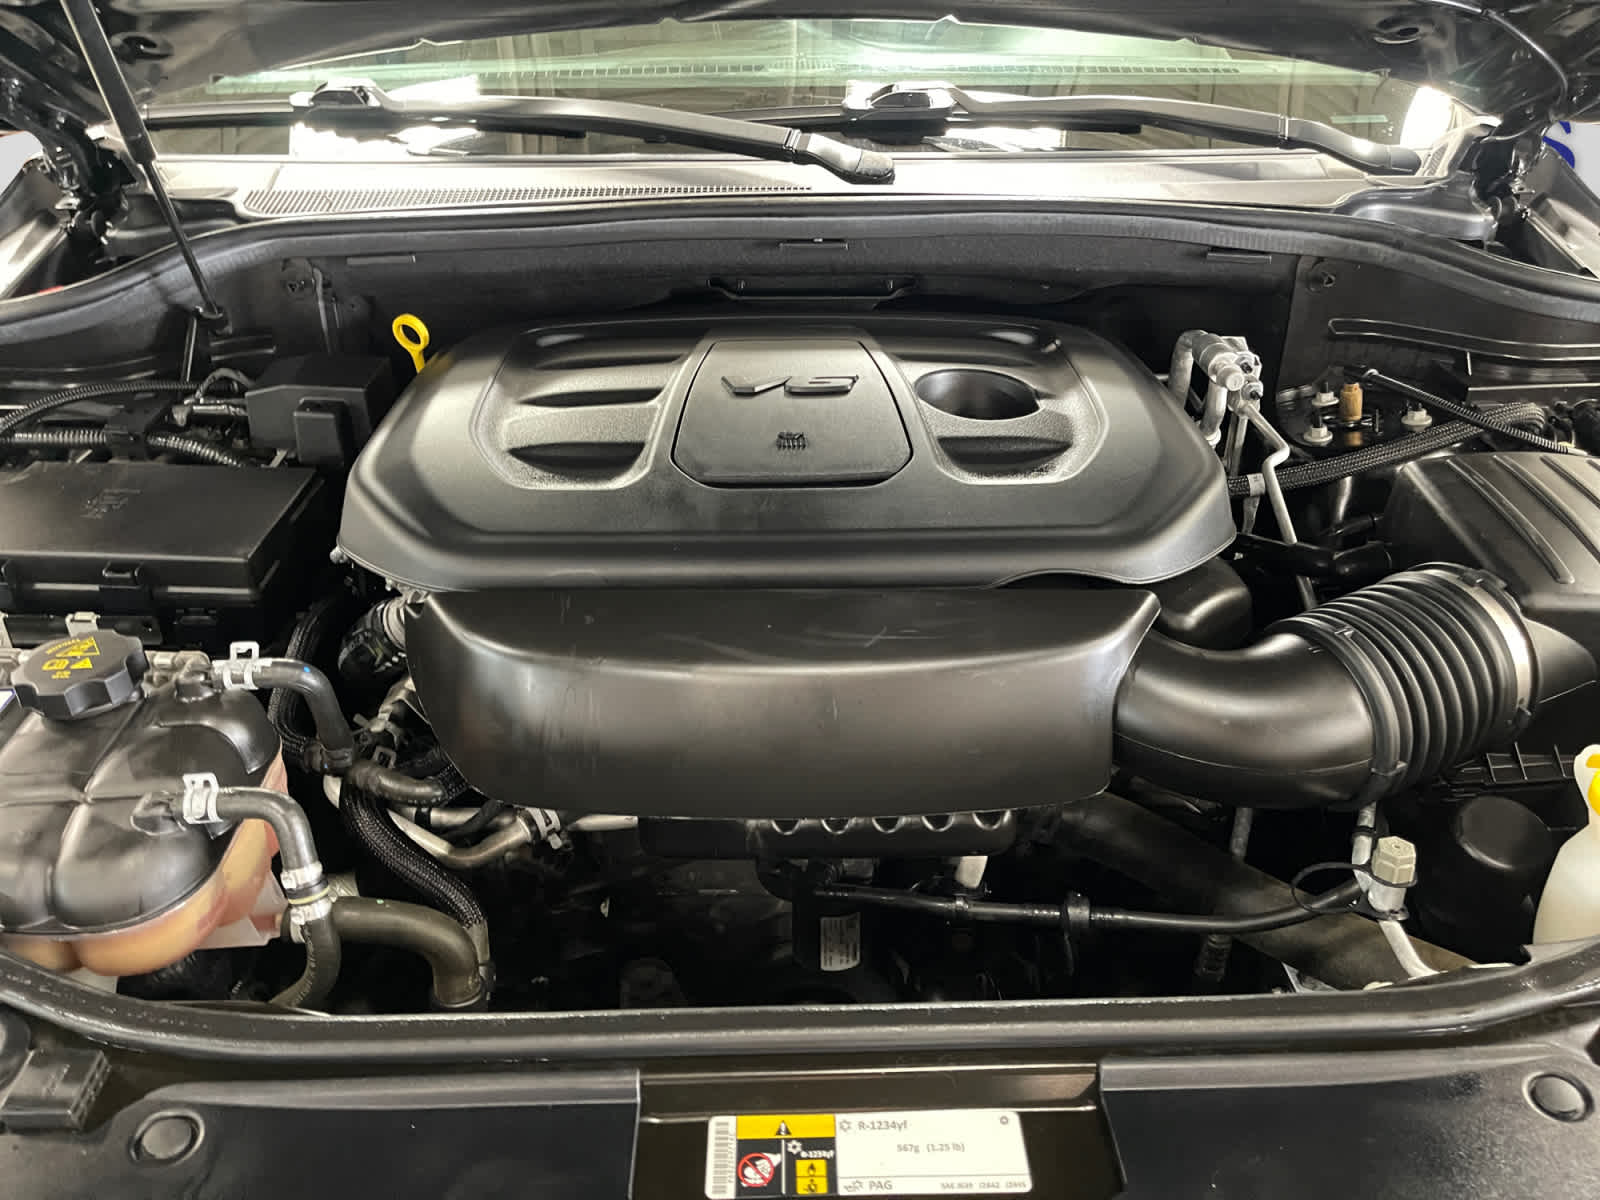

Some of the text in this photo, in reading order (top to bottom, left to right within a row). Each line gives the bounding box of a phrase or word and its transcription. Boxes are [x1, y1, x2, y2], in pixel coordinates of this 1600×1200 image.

[858, 1120, 908, 1132] R-1234yf
[897, 1143, 920, 1154] 567g
[869, 1180, 893, 1191] PAG
